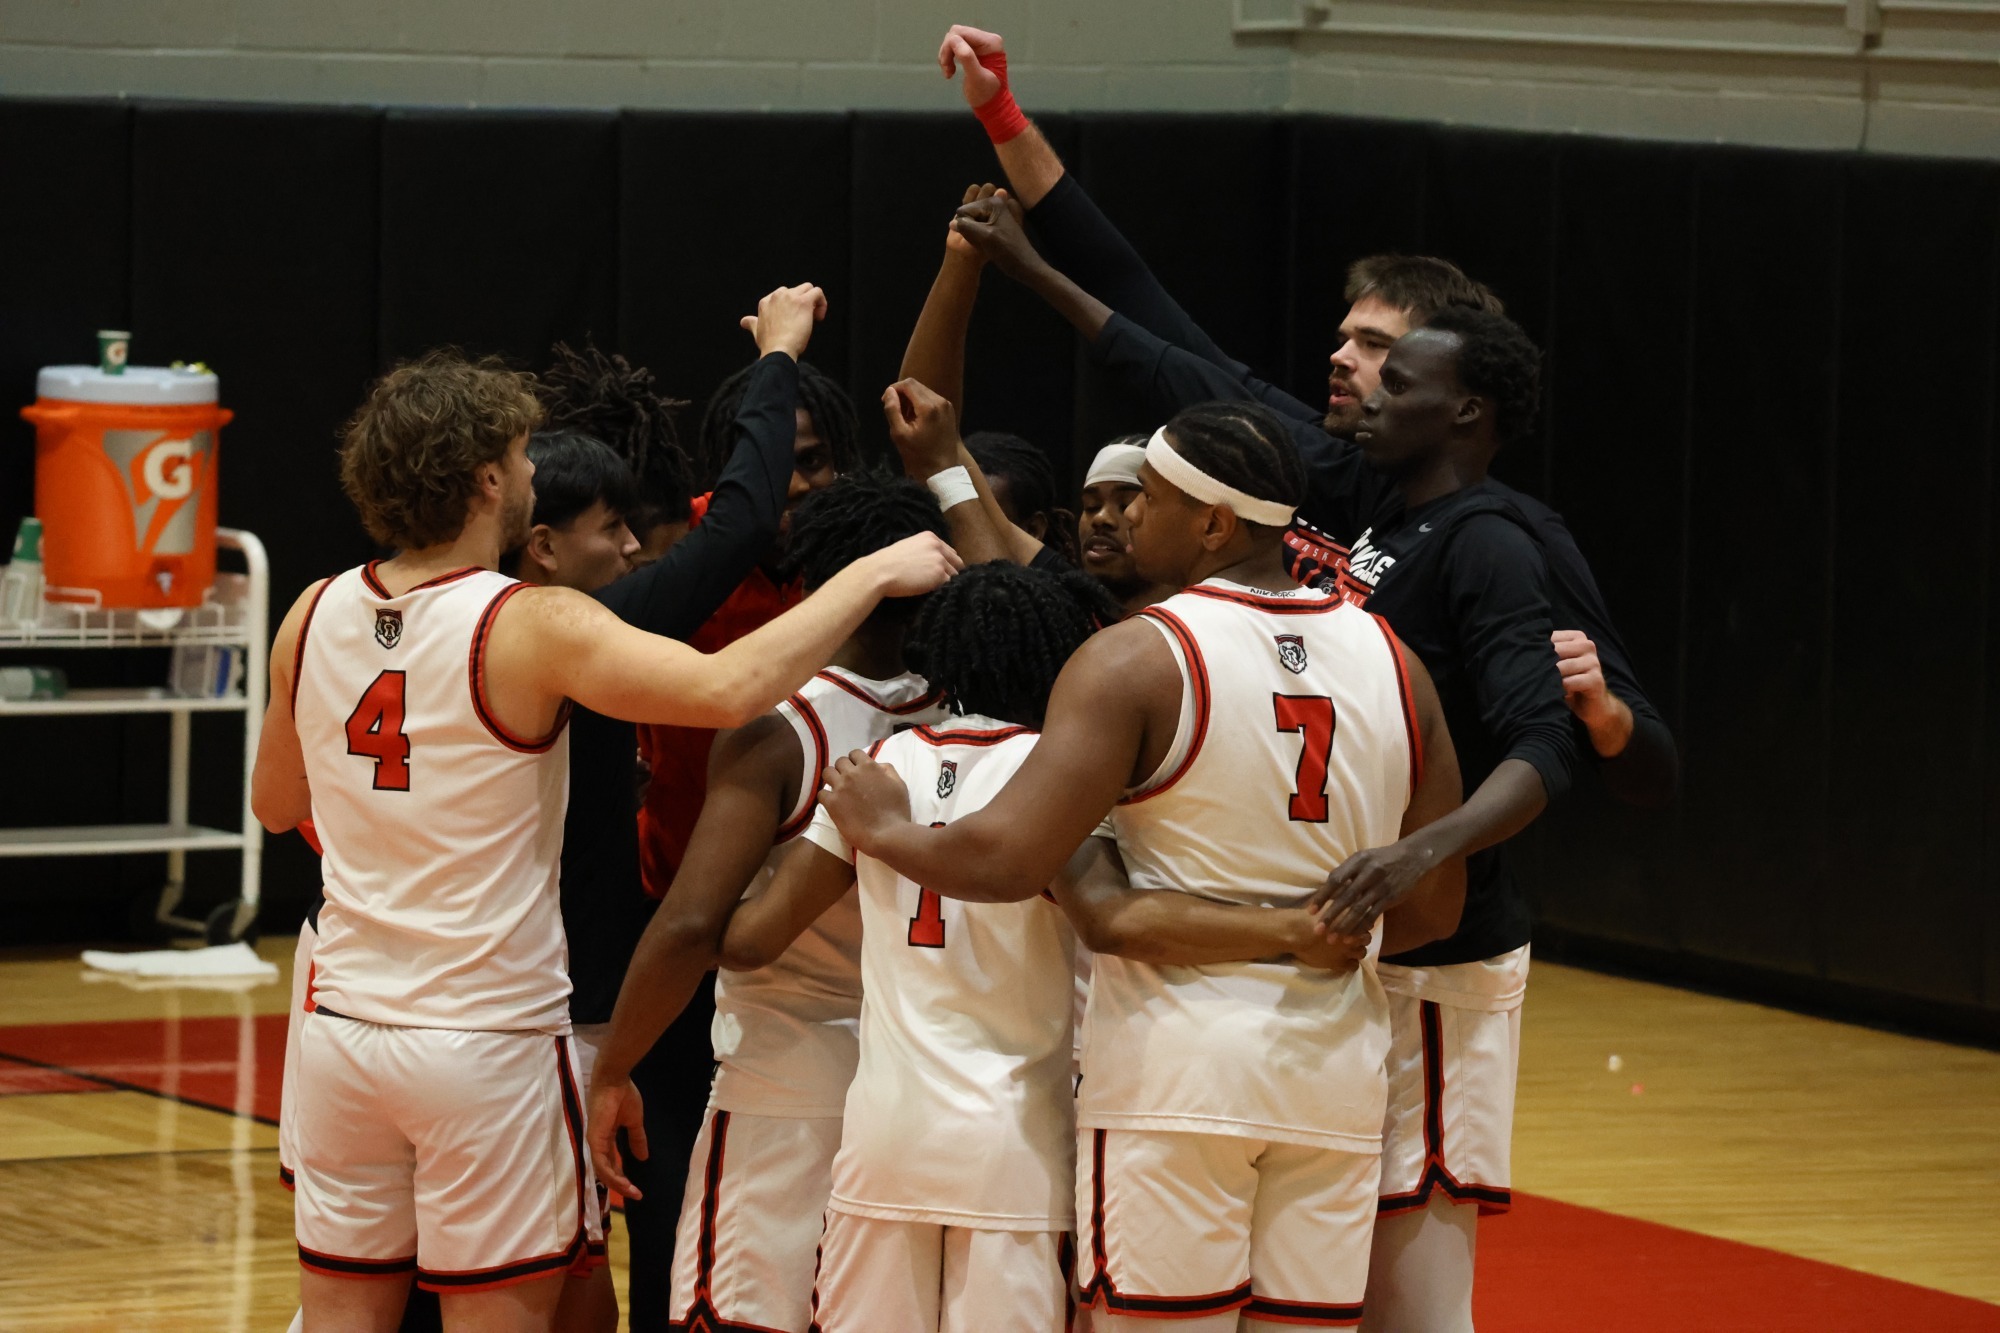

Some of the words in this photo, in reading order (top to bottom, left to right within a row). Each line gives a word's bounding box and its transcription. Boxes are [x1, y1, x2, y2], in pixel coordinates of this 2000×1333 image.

[144, 440, 192, 499] G
[1289, 537, 1343, 567] BASKE
[345, 669, 410, 792] 4
[1273, 692, 1336, 823] 7
